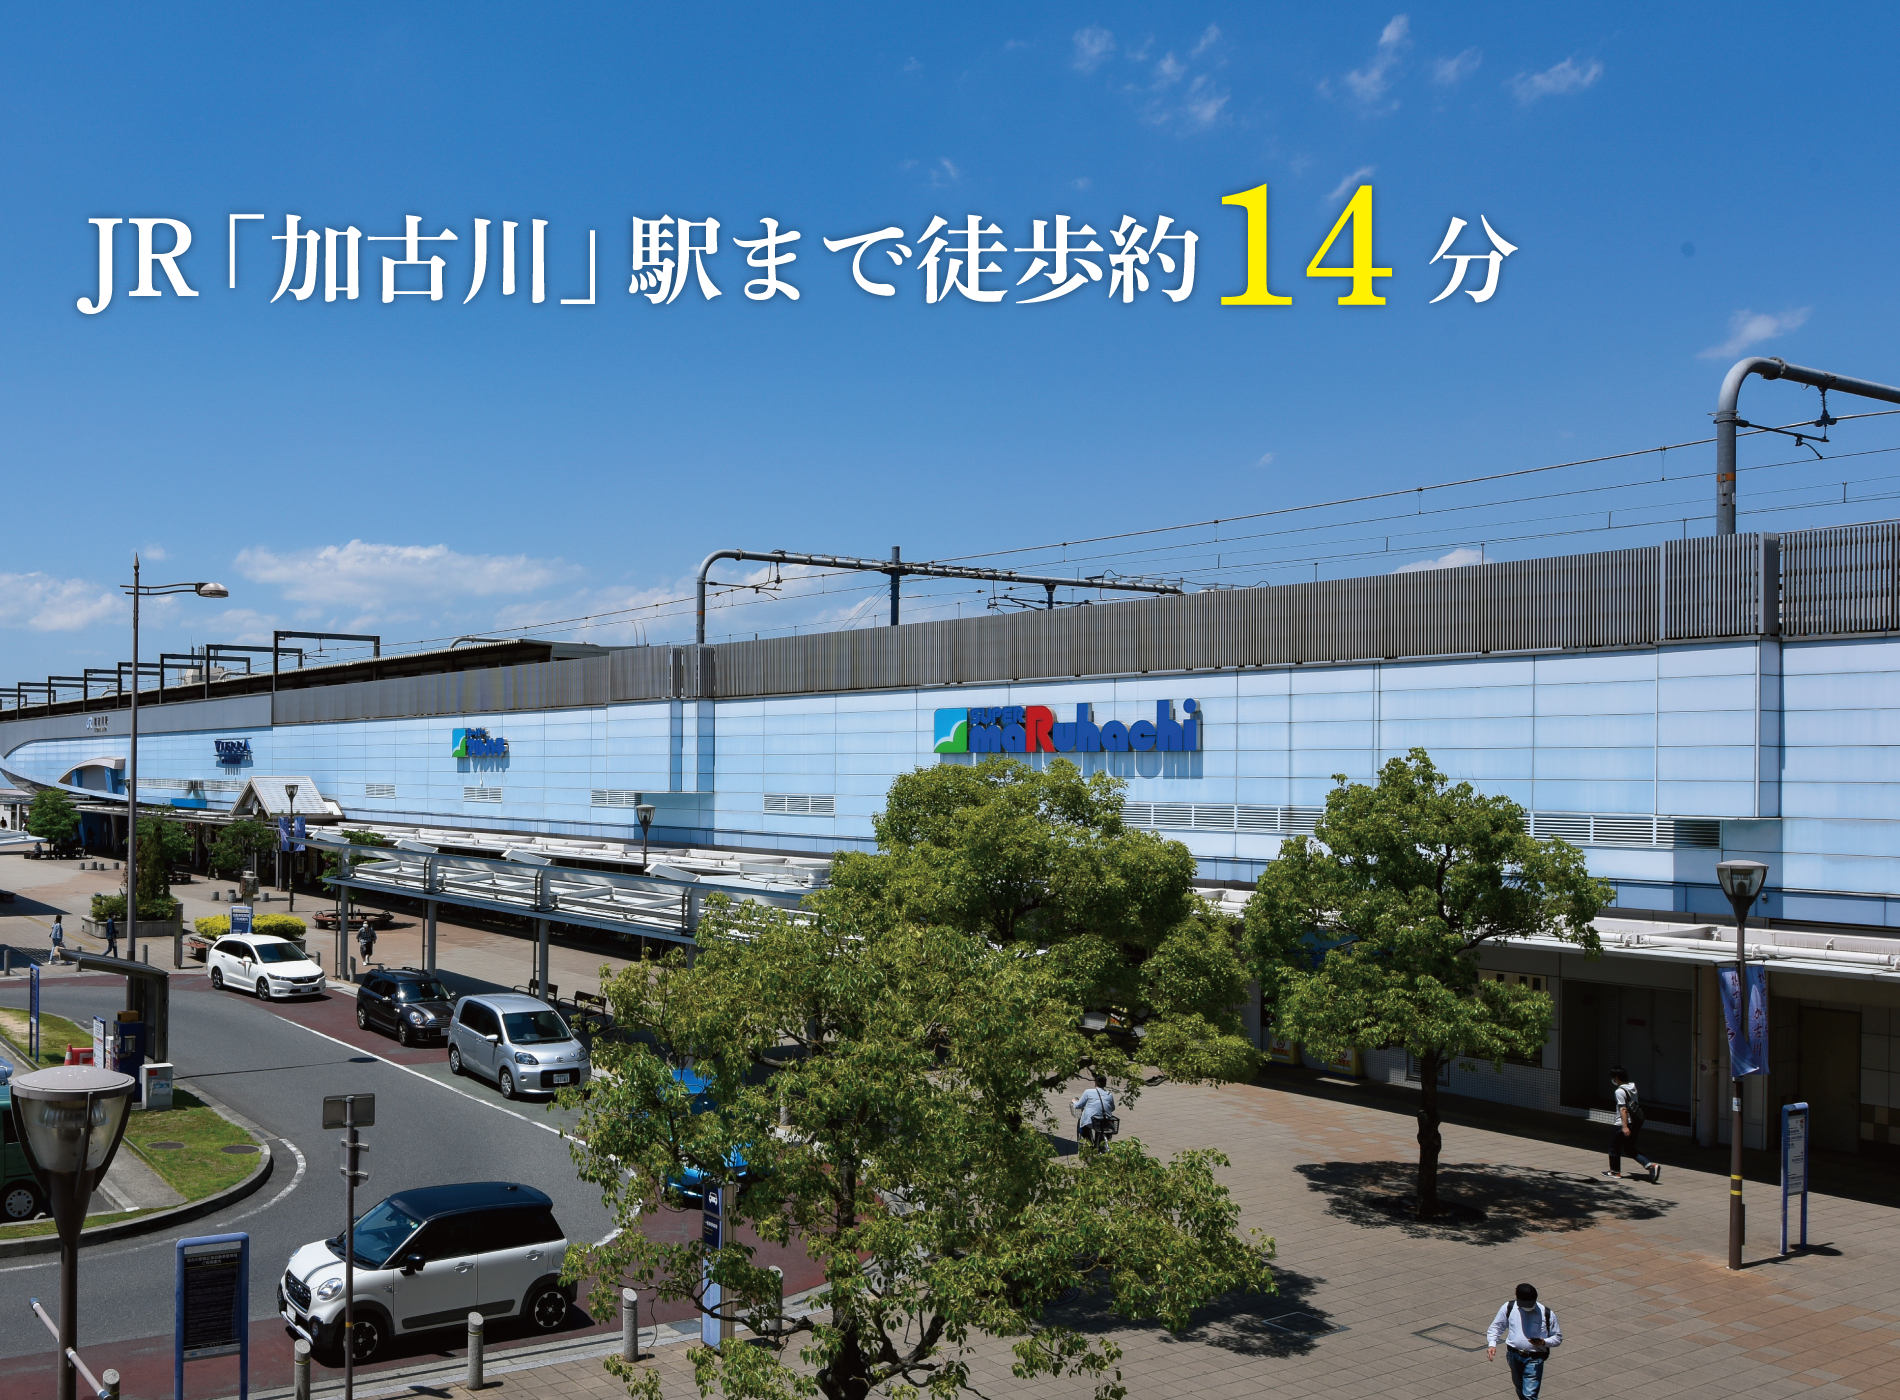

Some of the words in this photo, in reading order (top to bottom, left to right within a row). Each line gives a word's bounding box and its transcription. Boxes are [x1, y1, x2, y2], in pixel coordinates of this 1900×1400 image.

[969, 698, 1197, 753] maRuhachi
[970, 706, 1025, 725] SUPER
[1752, 1007, 1763, 1058] 加古川
